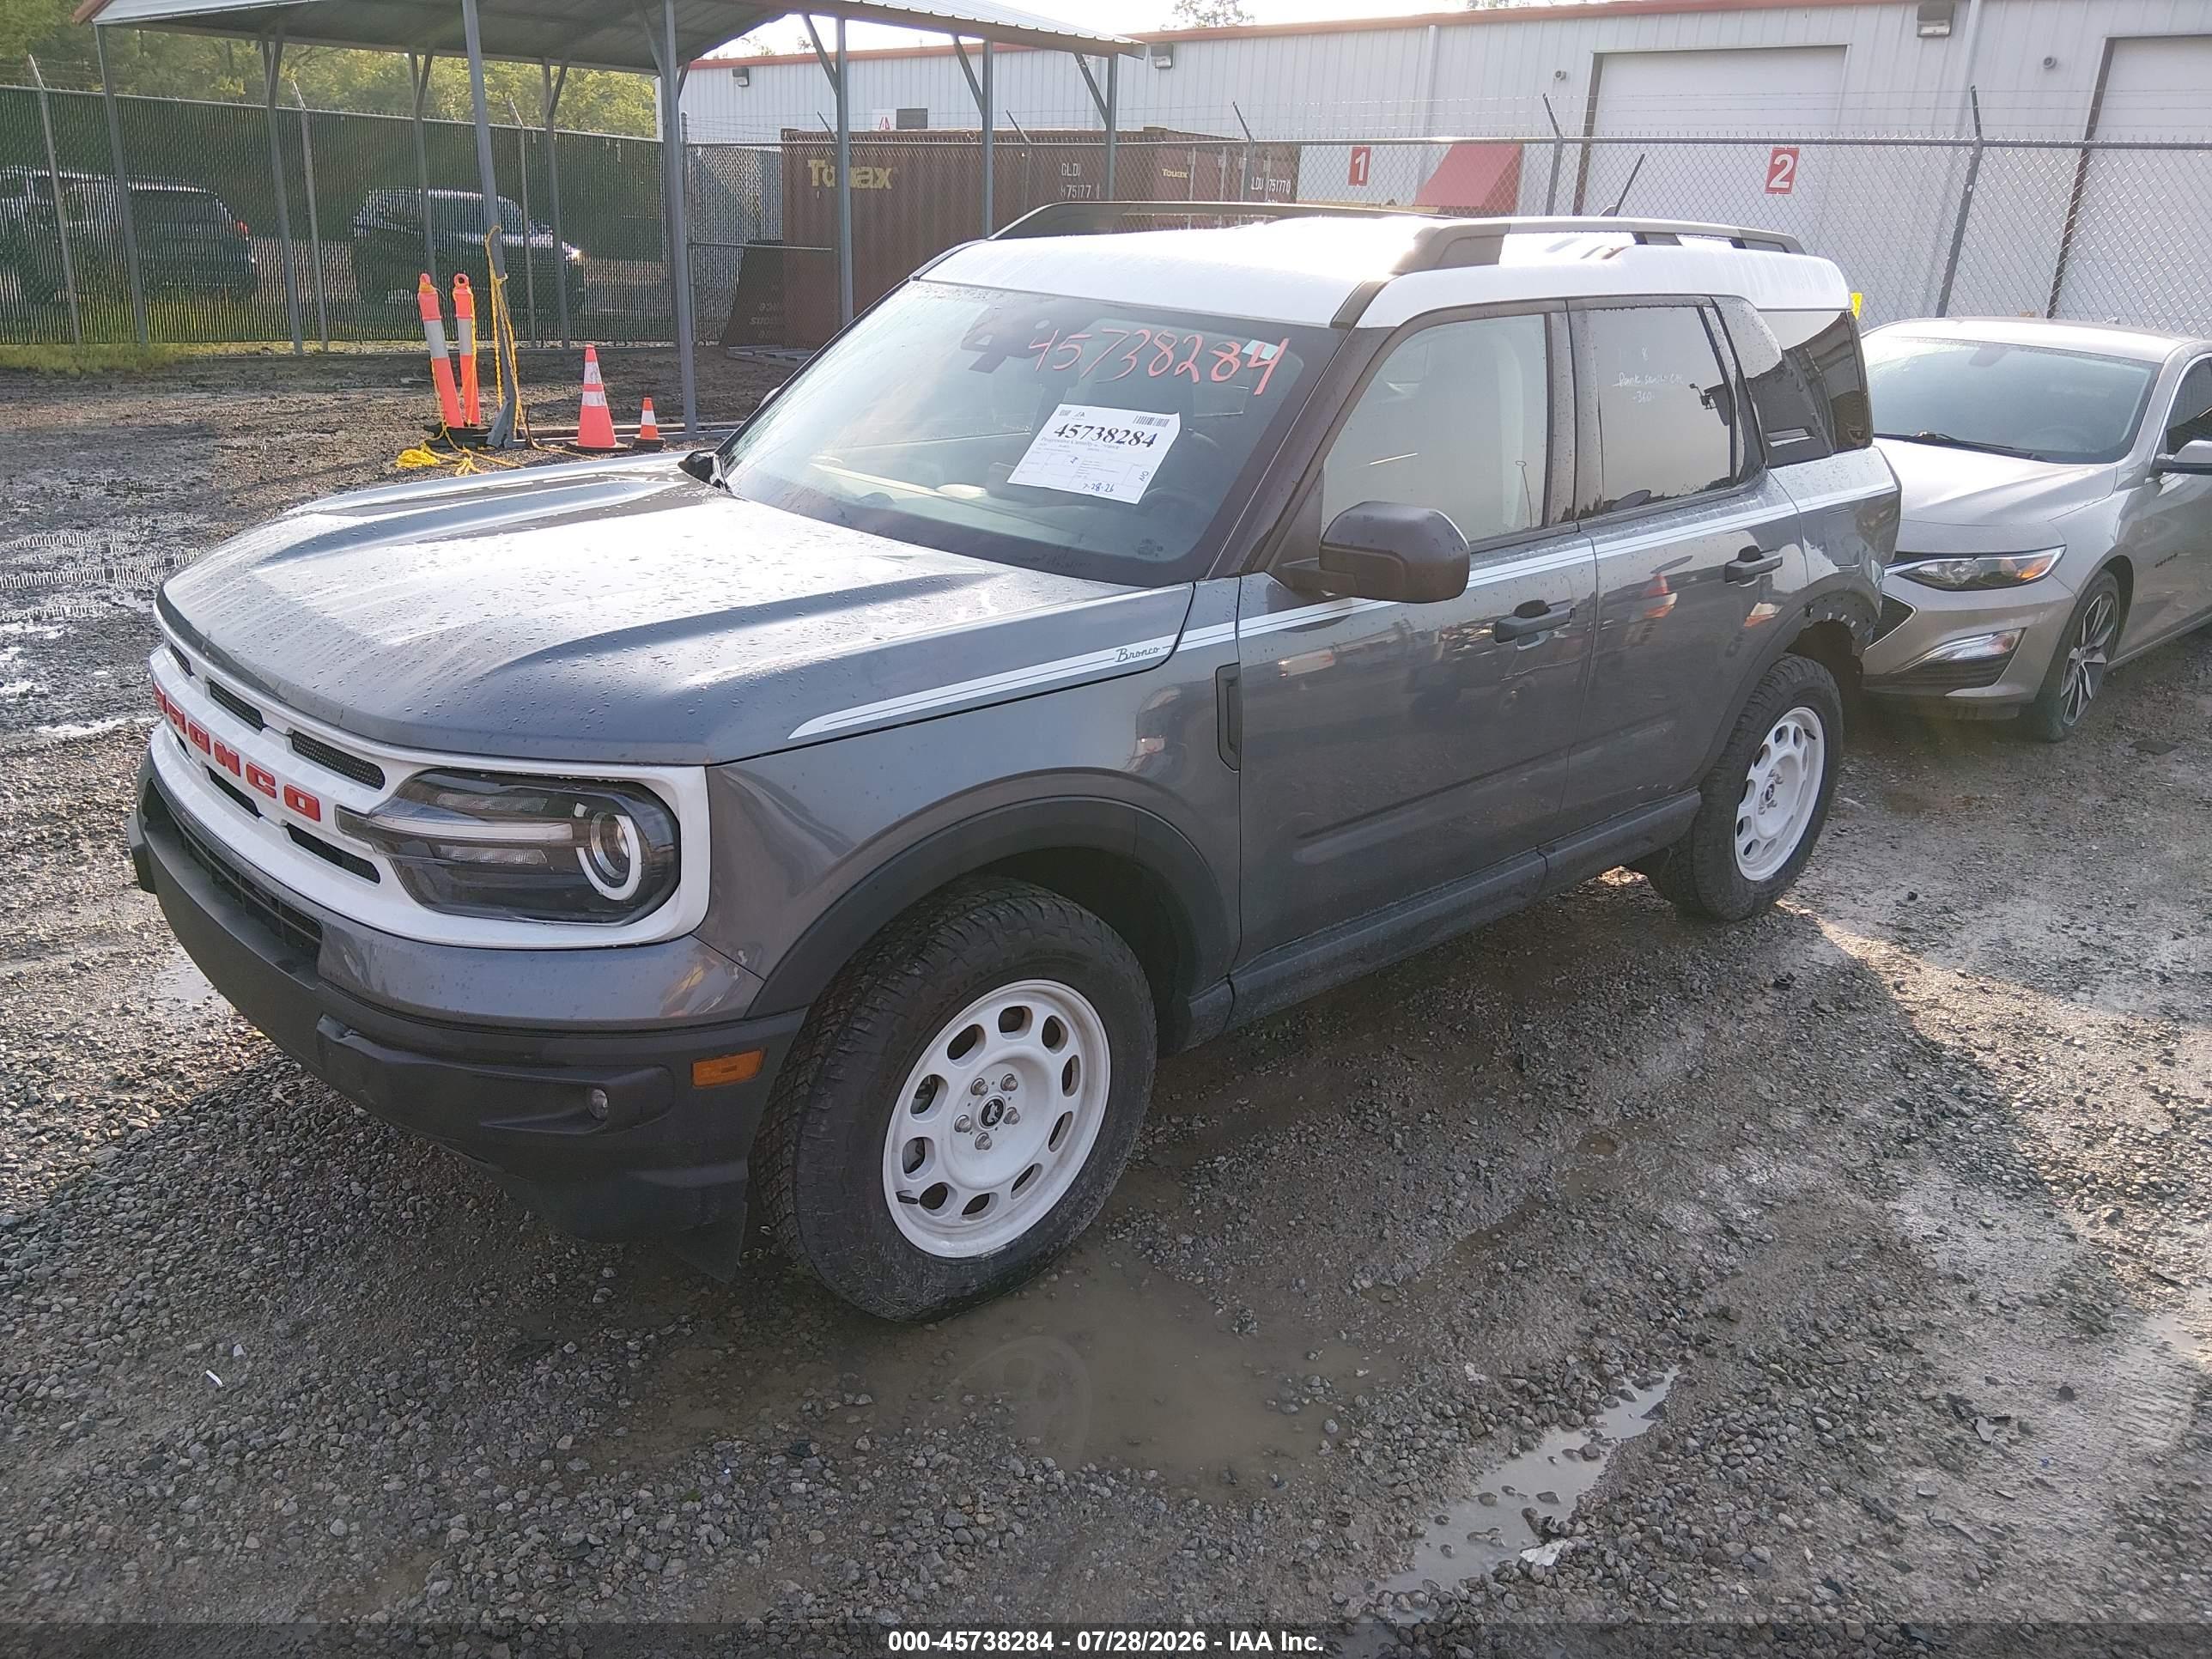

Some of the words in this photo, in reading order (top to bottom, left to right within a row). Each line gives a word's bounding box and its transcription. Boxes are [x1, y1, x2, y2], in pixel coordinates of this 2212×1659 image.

[1355, 151, 1366, 181] 1
[1769, 154, 1794, 188] 2
[1028, 328, 1290, 396] 45738284
[1054, 423, 1158, 448] 45738284
[1115, 646, 1160, 662] Bronco
[154, 681, 321, 823] BRONCO
